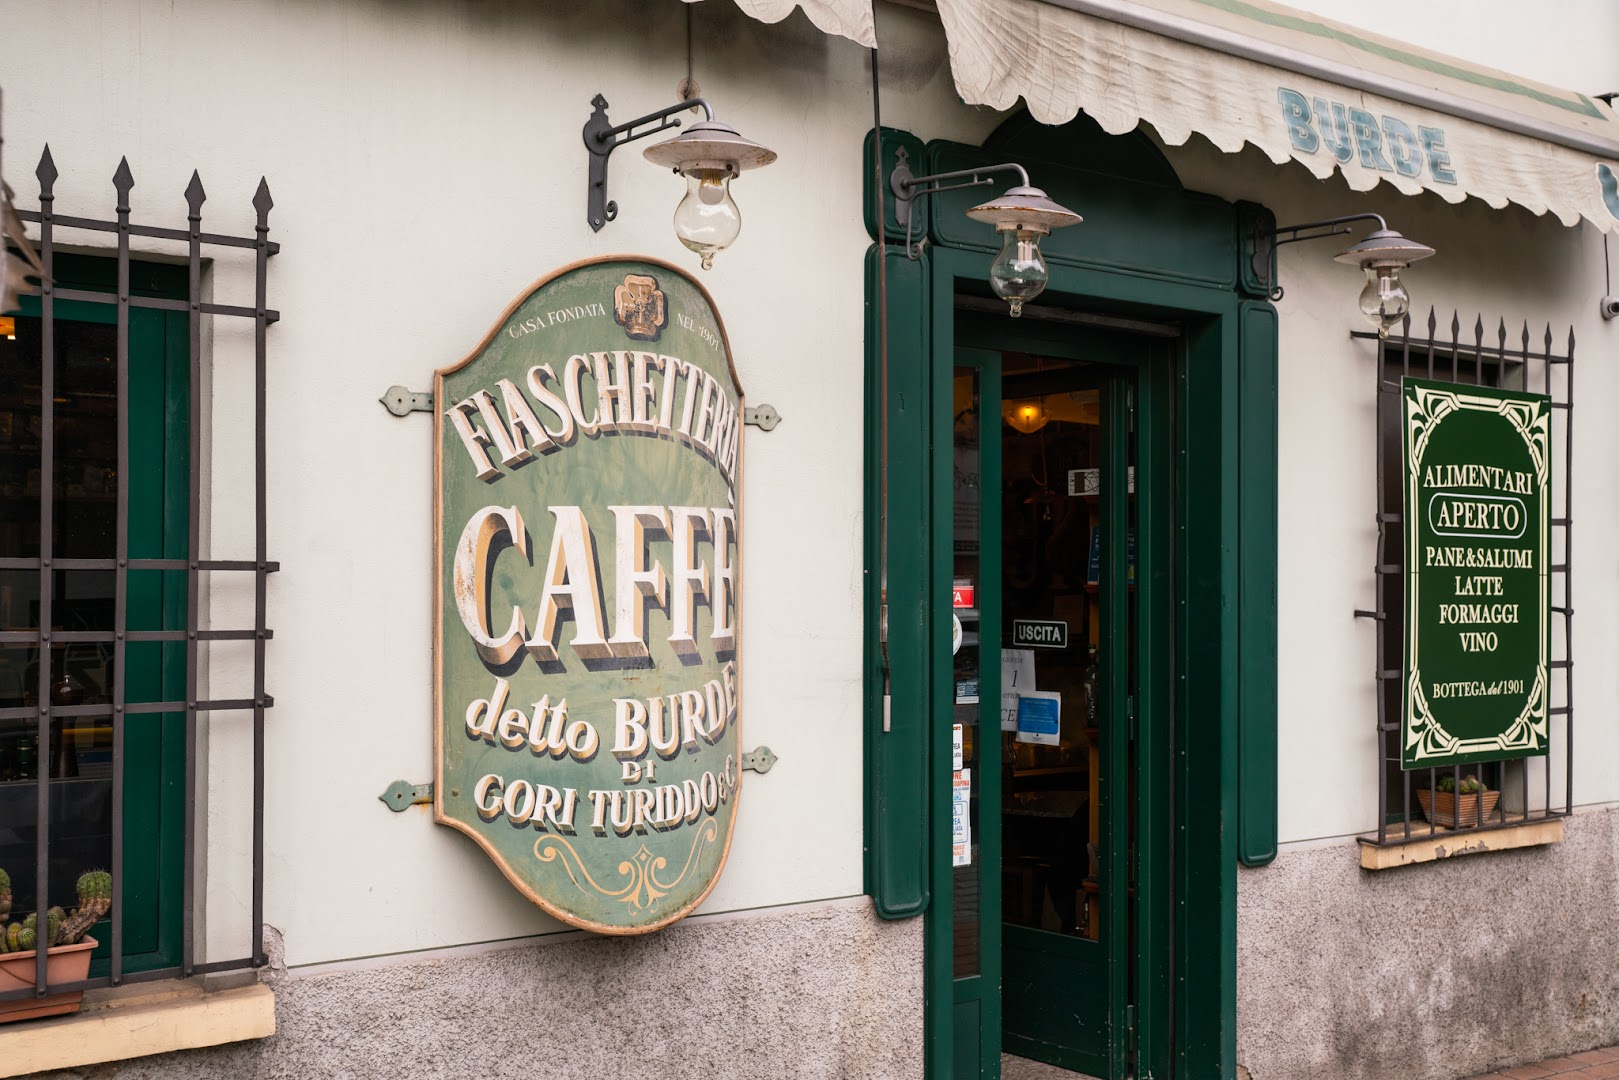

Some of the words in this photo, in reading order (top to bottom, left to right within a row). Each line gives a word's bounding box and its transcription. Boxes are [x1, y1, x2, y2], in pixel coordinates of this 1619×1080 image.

[1278, 87, 1458, 186] BURDE
[508, 316, 546, 340] CASA
[547, 302, 607, 328] FONDATA
[676, 312, 695, 333] NEL
[698, 325, 720, 352] 1901
[444, 350, 740, 487] FIASCHETTERIA
[1423, 464, 1533, 495] ALIMENTARI
[1437, 501, 1520, 531] APERTO
[1425, 546, 1533, 569] PANE&SALUMI
[1454, 575, 1504, 596] LATTE
[1439, 604, 1519, 624] FORMAGGI
[1018, 624, 1061, 643] USCITA
[1459, 631, 1499, 652] VINO
[1011, 669, 1018, 688] 1
[1432, 681, 1487, 699] BOTTEGA
[1487, 680, 1503, 696] dal
[1502, 679, 1525, 695] 1901
[465, 676, 599, 758] detto
[609, 660, 738, 758] BURDE
[620, 759, 657, 783] DI
[474, 773, 580, 835] GORI
[588, 771, 718, 836] TURIDDO
